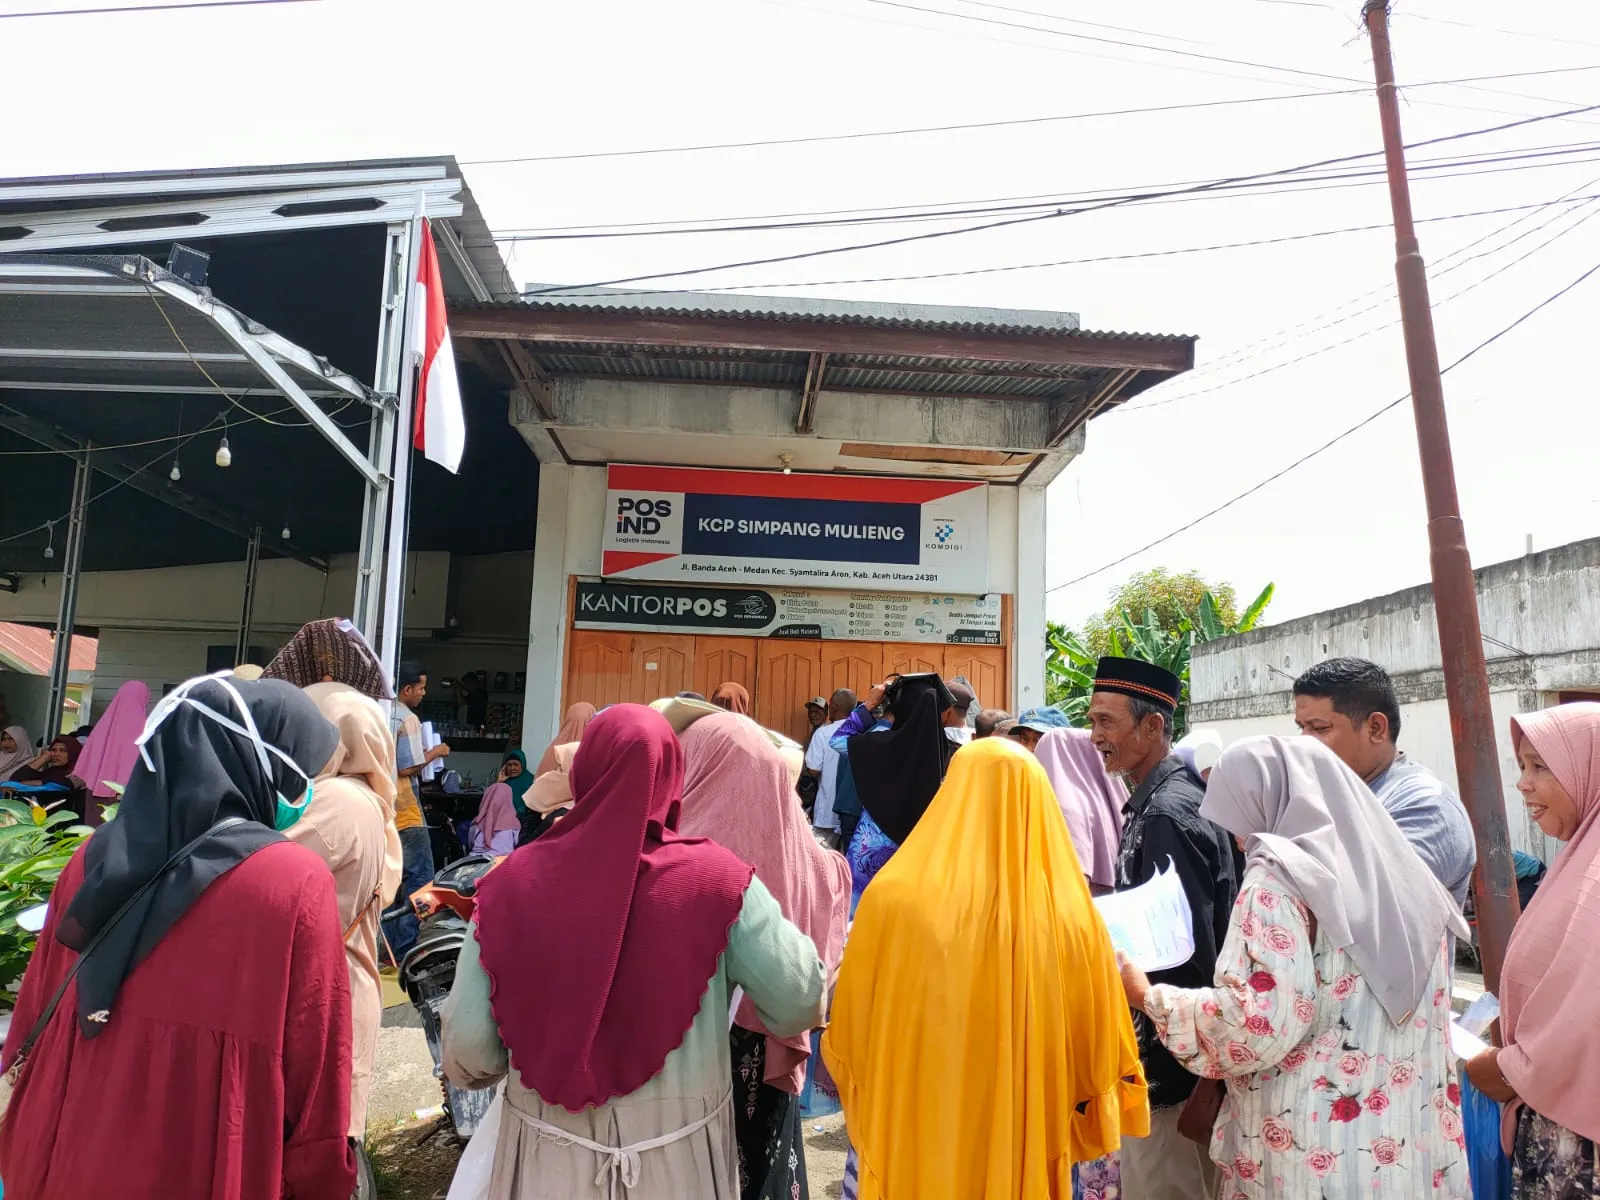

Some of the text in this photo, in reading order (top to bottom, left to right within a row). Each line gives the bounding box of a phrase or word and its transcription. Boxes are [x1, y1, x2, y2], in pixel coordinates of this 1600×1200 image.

[618, 497, 671, 517] POS
[698, 517, 905, 541] KCP SIMPANG MULIENG
[681, 563, 689, 571] Jl.
[691, 563, 716, 572] Banda
[717, 565, 737, 573] Aceh
[743, 566, 769, 574] Medan
[771, 567, 788, 575] Kec.
[789, 568, 829, 577] Syamtalira
[831, 570, 851, 578] Aron,
[853, 571, 870, 579] Kab.
[871, 572, 891, 580] Aceh
[892, 573, 913, 581] Utara
